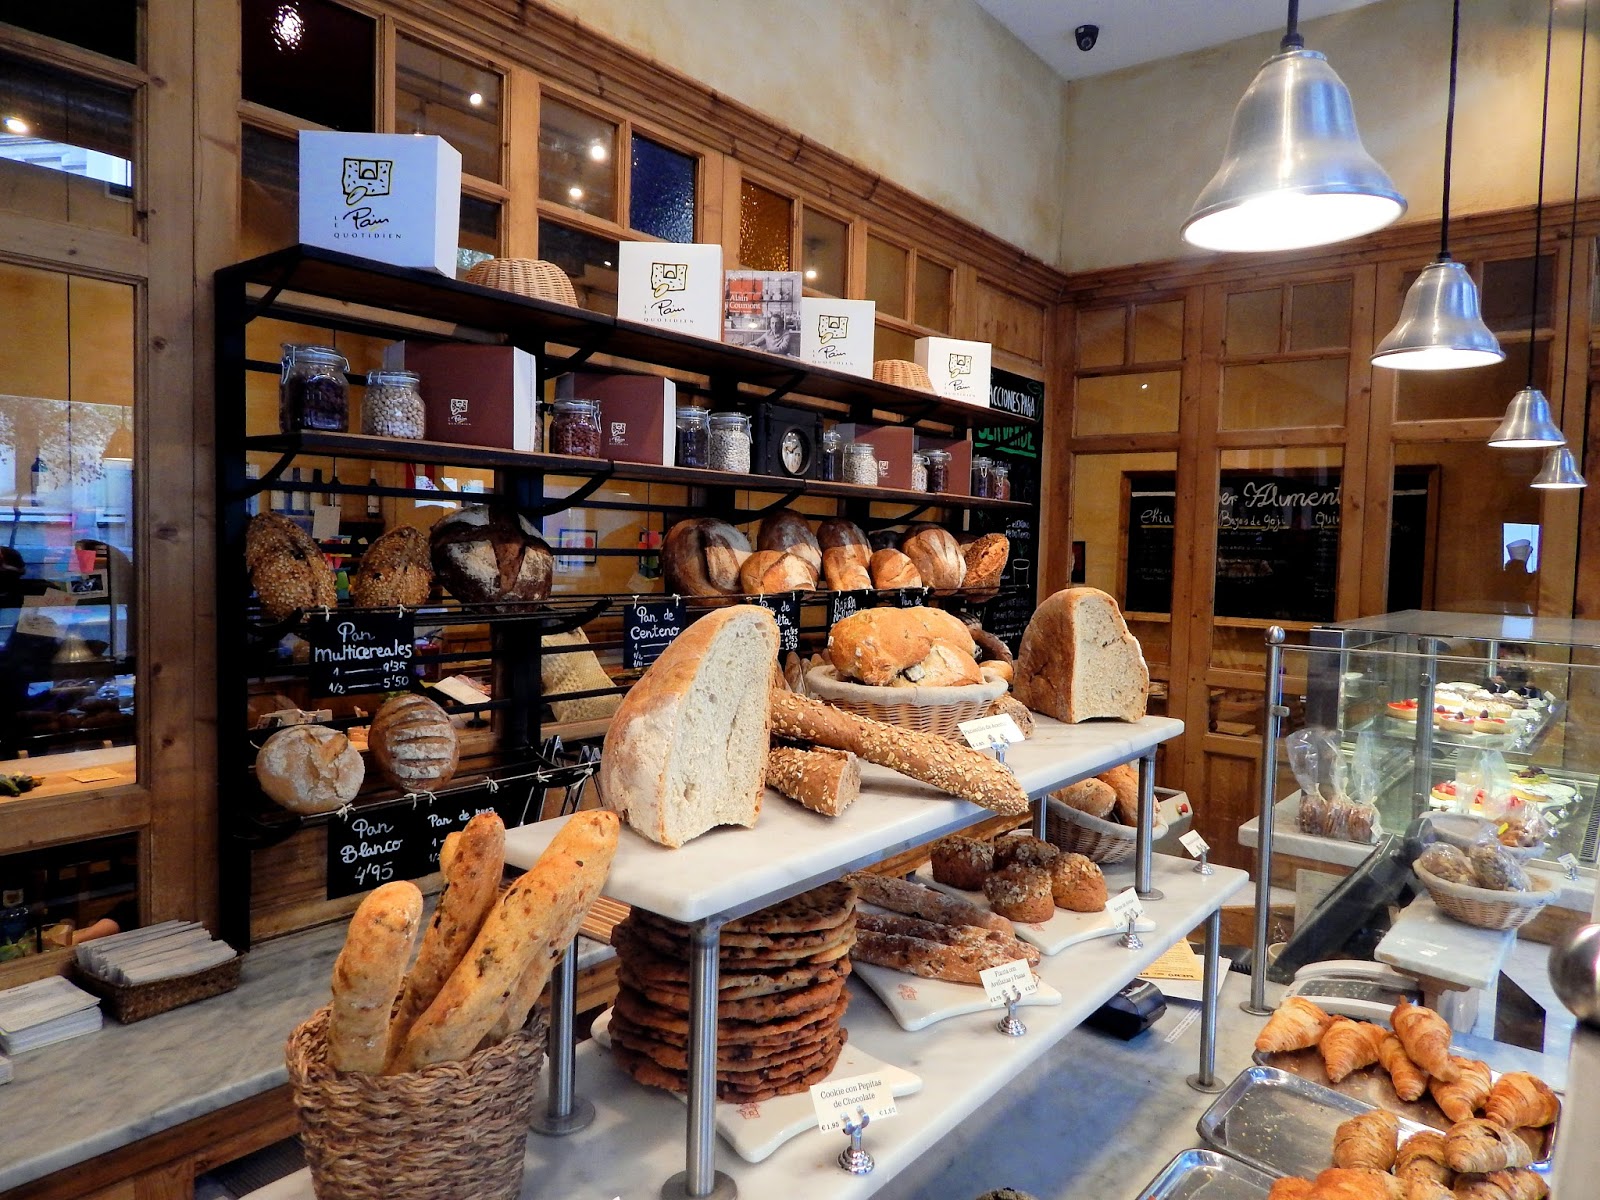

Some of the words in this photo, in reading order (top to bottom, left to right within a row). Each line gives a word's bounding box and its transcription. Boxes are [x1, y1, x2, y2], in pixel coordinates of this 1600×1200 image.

[342, 207, 390, 230] Pain
[729, 293, 749, 302] Alain
[650, 299, 685, 317] Pain
[636, 606, 659, 624] Pan
[663, 608, 675, 622] de
[780, 601, 791, 613] de
[337, 621, 376, 643] Pan
[630, 624, 680, 640] Centeno
[427, 813, 453, 828] Pan
[458, 809, 471, 822] de
[351, 818, 395, 840] Pan
[340, 839, 404, 864] Blanco
[820, 1087, 845, 1100] Cookie
[845, 1084, 858, 1094] con
[858, 1079, 882, 1092] Pepitas
[833, 1100, 842, 1108] de
[842, 1092, 876, 1106] Chocolate
